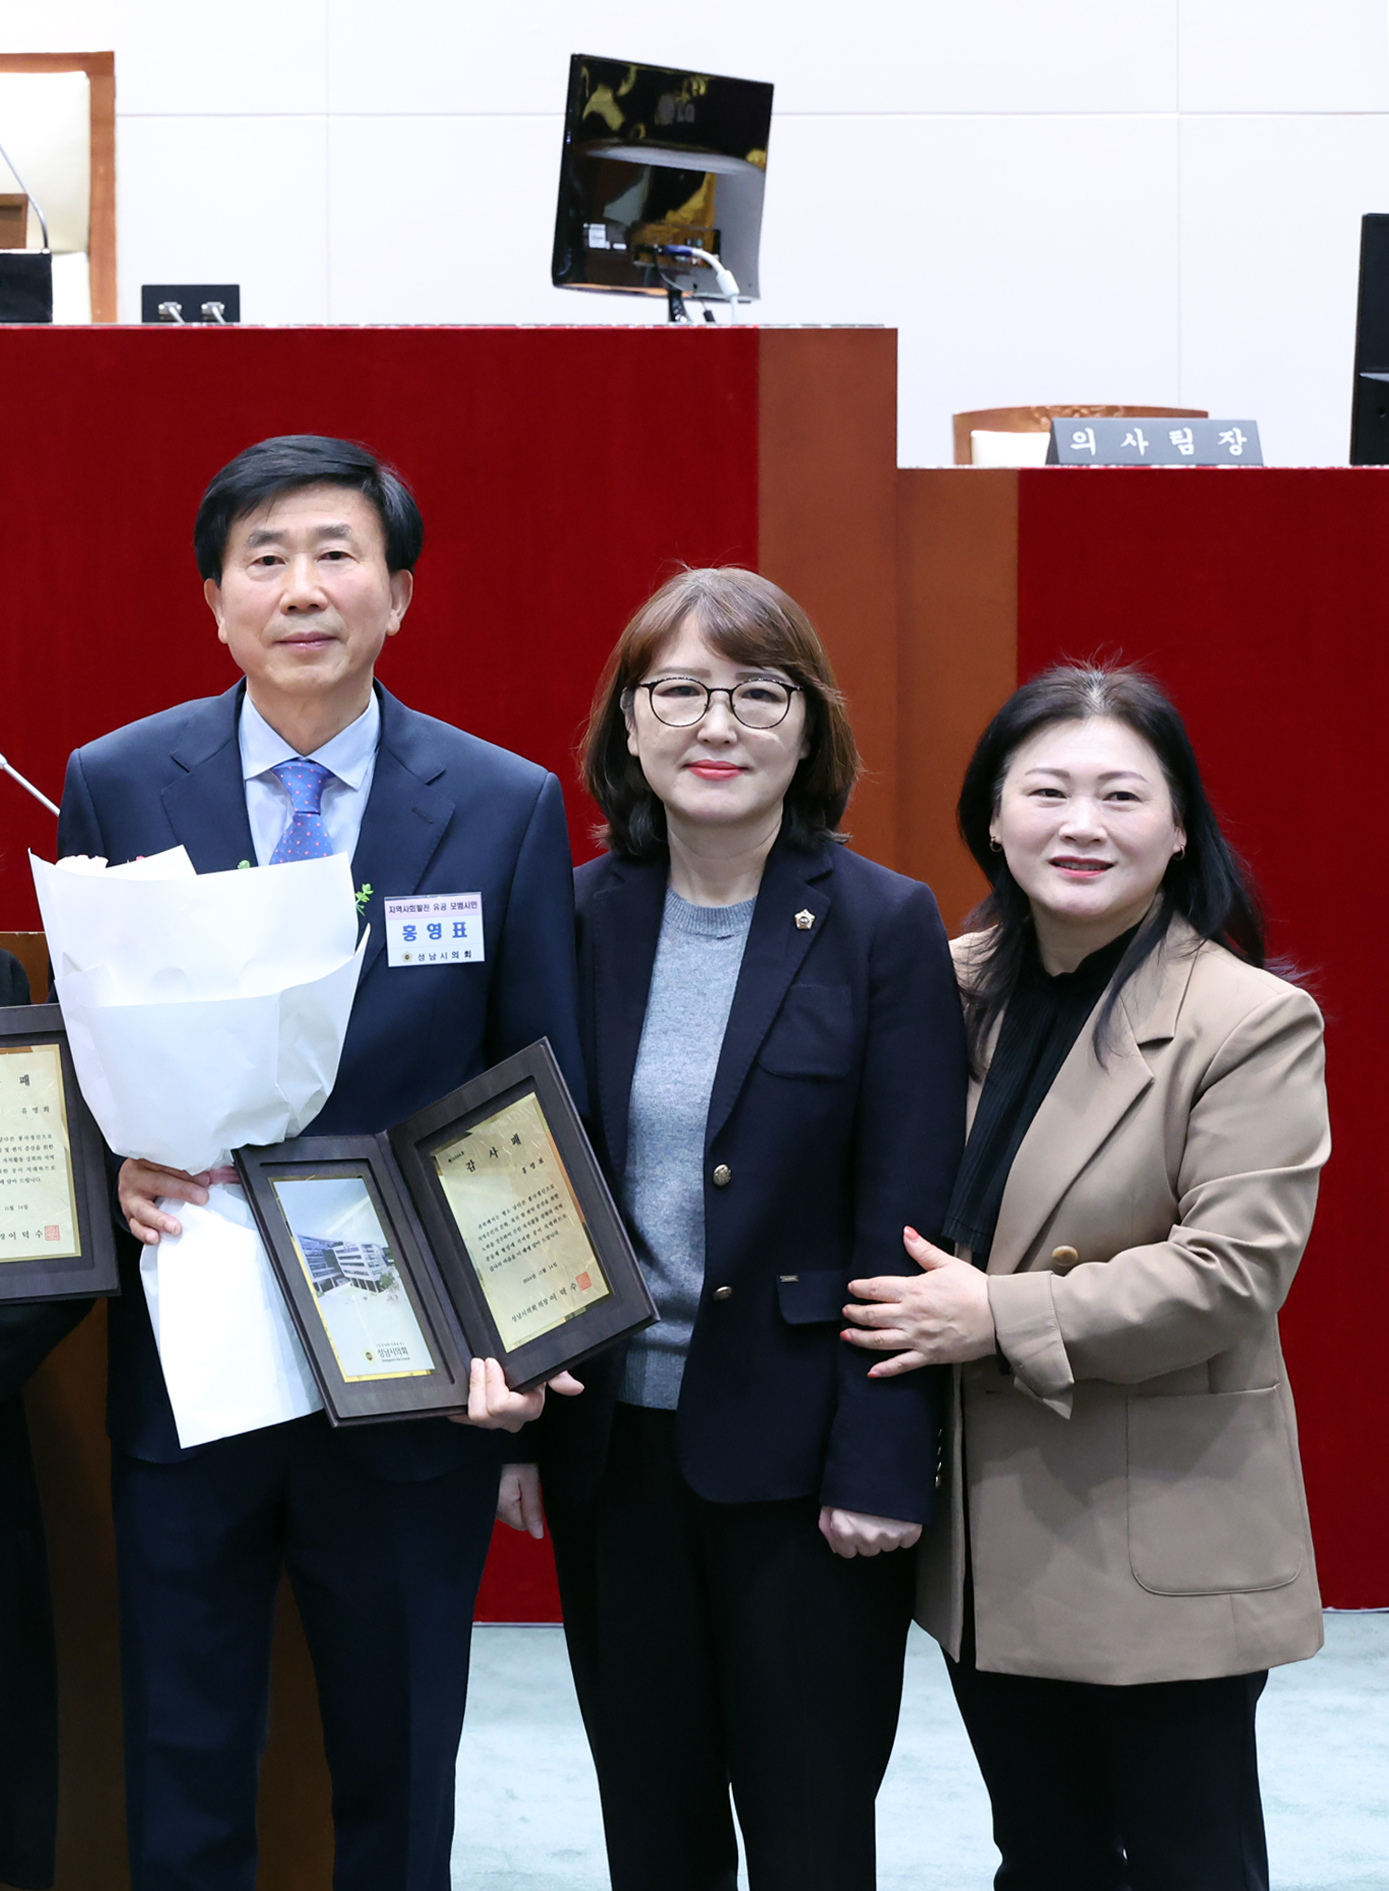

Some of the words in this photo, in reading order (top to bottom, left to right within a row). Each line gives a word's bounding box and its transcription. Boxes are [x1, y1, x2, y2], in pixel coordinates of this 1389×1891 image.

[388, 904, 430, 914] 지역사회발전
[433, 903, 447, 911] 유공
[450, 900, 478, 910] 모범시민
